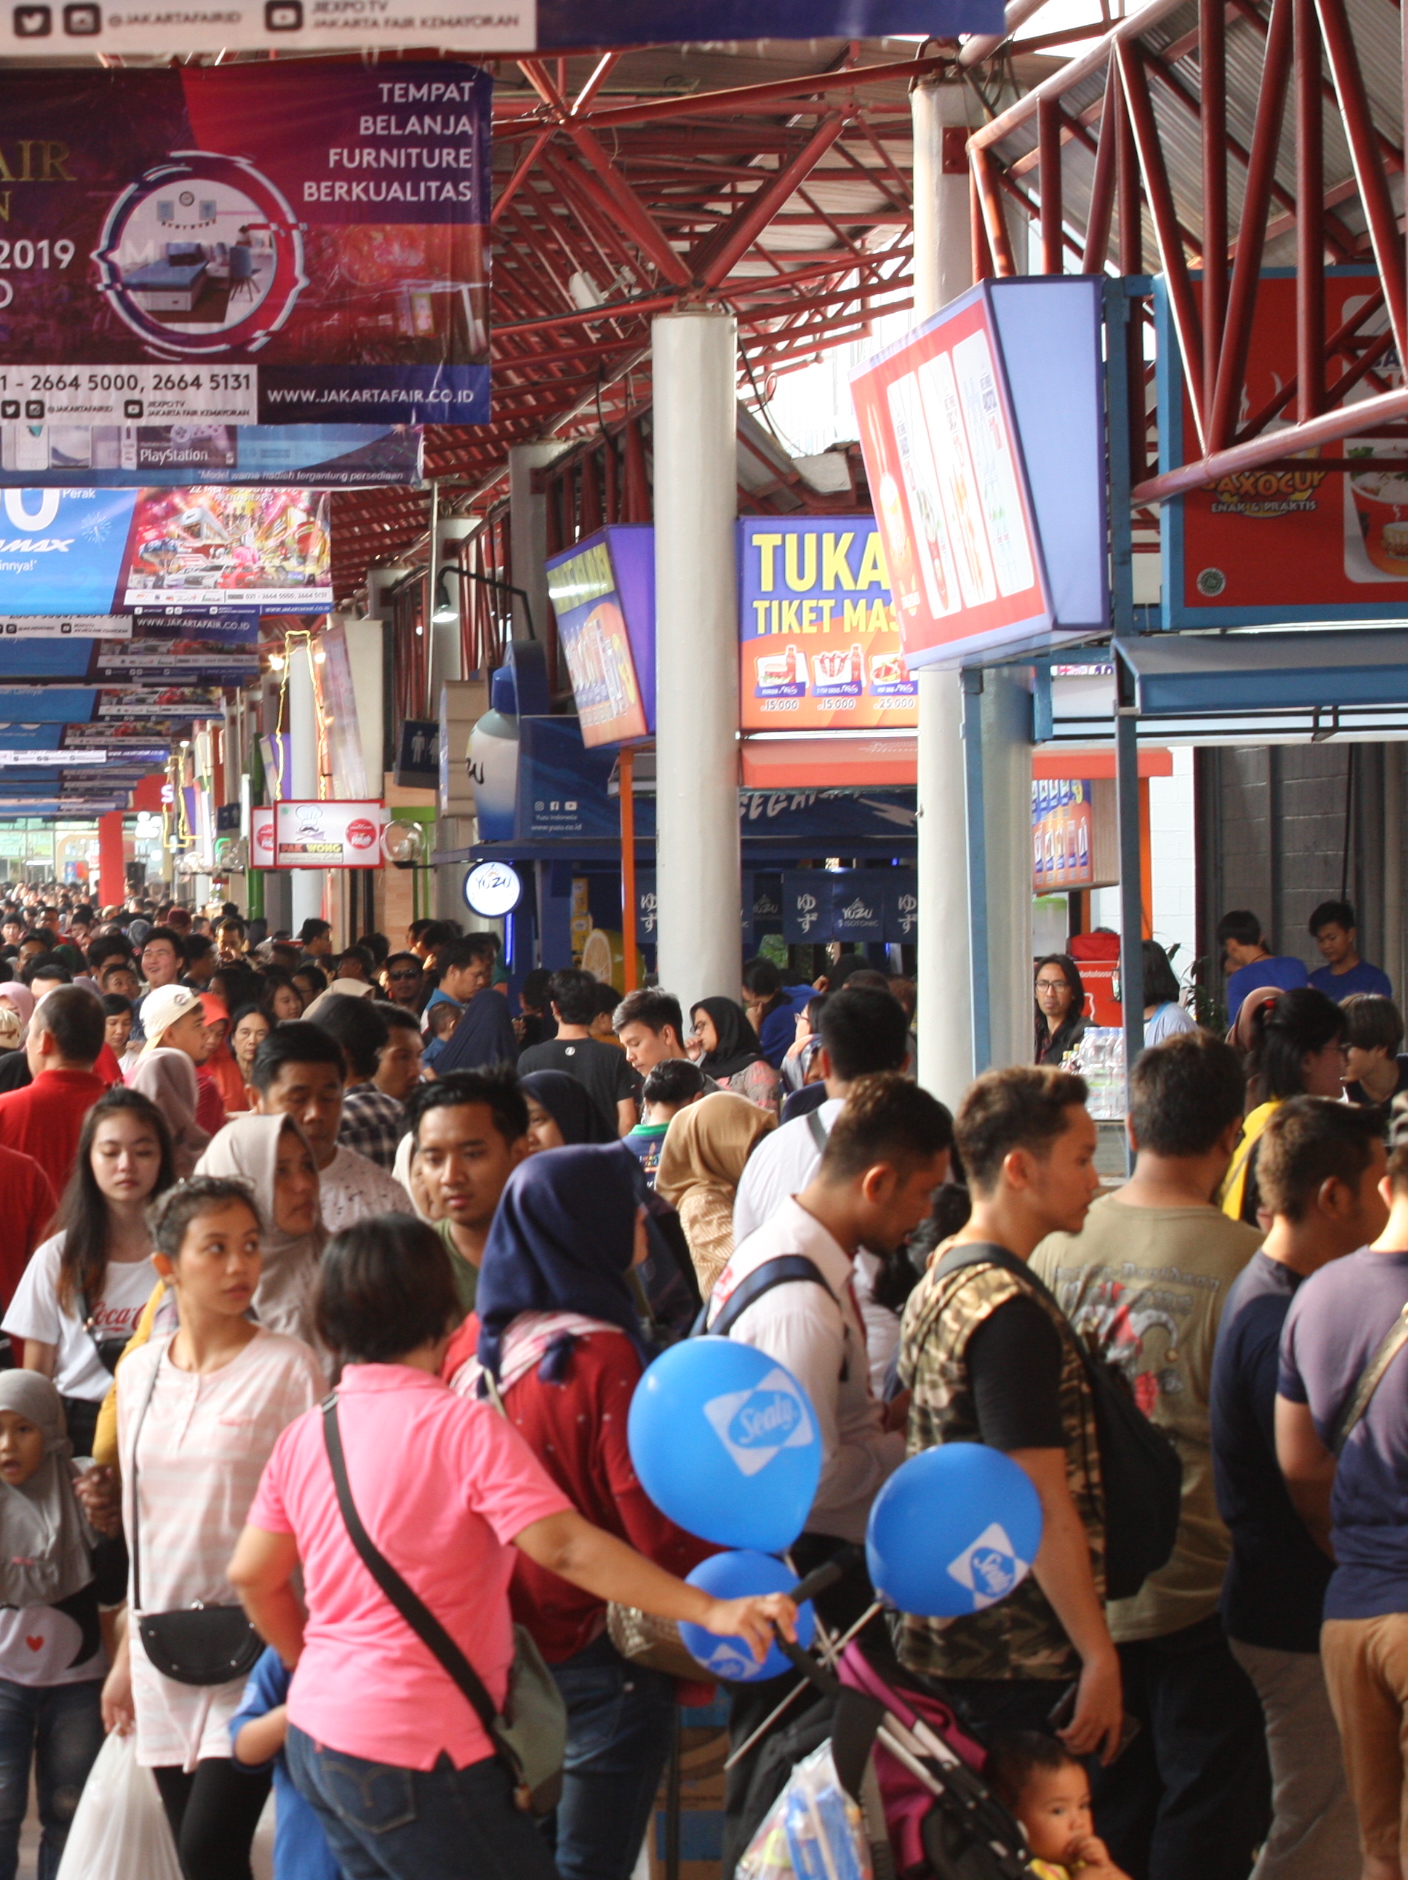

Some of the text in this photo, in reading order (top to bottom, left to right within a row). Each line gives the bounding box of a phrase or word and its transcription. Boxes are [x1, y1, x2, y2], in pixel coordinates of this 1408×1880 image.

[312, 14, 520, 30] JAKARTA FAIR KEMAYORAN
[378, 82, 474, 103] TEMPAT
[359, 115, 473, 136] BELANJA
[328, 147, 473, 169] FURNITURE
[303, 180, 473, 203] BERKUALITAS
[31, 375, 81, 391] 2664
[88, 374, 146, 393] 5000,
[152, 374, 203, 391] 2664
[210, 373, 251, 390] 5131
[267, 388, 475, 404] WWW.JAKARTAFAIR.CO.ID
[140, 448, 209, 466] PlayStation
[1211, 500, 1317, 514] ENAK & PRAKTIS
[752, 532, 892, 592] TUKA
[752, 597, 900, 635] TIKET MAS
[474, 876, 513, 891] YUZU
